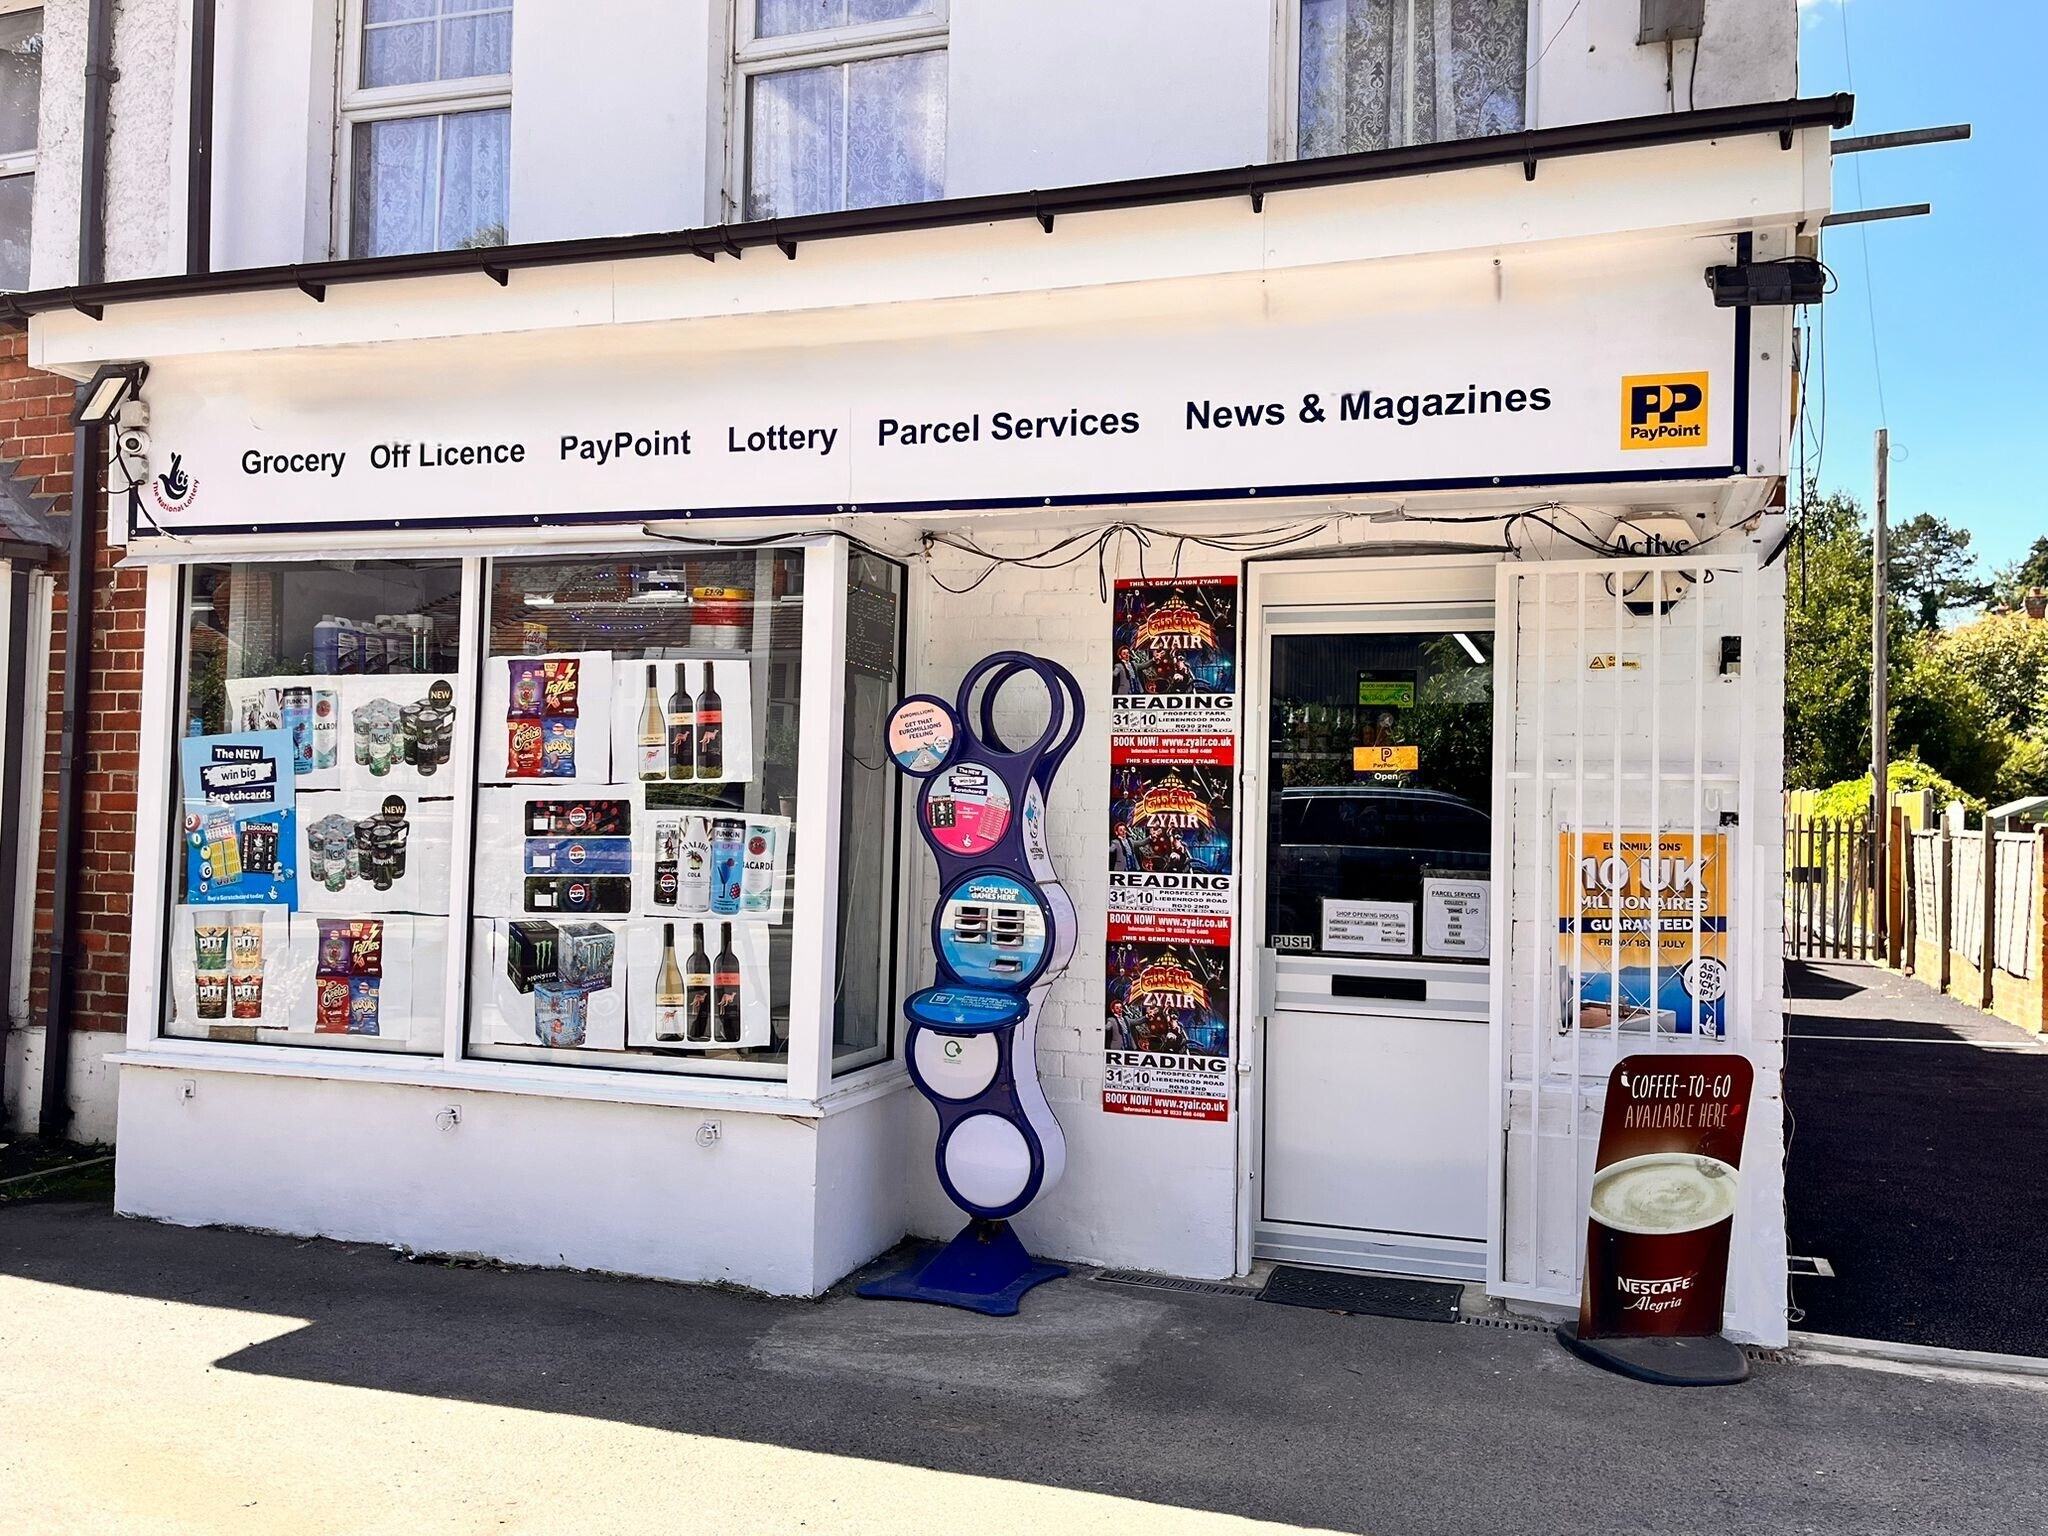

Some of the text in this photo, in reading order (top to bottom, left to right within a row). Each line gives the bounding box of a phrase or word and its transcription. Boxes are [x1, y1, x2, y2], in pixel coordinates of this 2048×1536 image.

[242, 385, 1550, 477] Grocery Off Licence PayPoint Lottery Parcel Services News & Magazines
[1631, 424, 1700, 441] PayPoint
[157, 497, 184, 512] National
[184, 479, 200, 507] Lottery
[1615, 533, 1690, 554] Active
[1150, 635, 1202, 649] ZYAIR
[431, 691, 450, 699] NEW
[1113, 697, 1233, 709] READING
[905, 720, 917, 728] GET
[1114, 714, 1129, 725] 31
[1141, 714, 1156, 725] 10
[899, 722, 942, 735] EUROMILLIONS
[909, 730, 933, 739] FEELING
[1113, 737, 1232, 748] BOOK NOW! www.zyair.co.uk
[215, 749, 260, 759] The NEW
[221, 769, 256, 780] win big
[1374, 773, 1398, 781] Open
[209, 790, 272, 802] Scratchcards
[384, 806, 404, 814] NEW
[1147, 814, 1199, 828] ZYAIR
[1582, 857, 1707, 892] 10 UK
[1110, 874, 1229, 889] READING
[969, 885, 998, 894] CHOOSE
[971, 892, 996, 900] GAMES
[1110, 891, 1125, 902] 31
[1138, 892, 1152, 903] 10
[1110, 914, 1228, 928] BOOK NOW! www.zyair.co.uk
[199, 937, 224, 949] POT
[234, 937, 259, 948] POT
[1273, 936, 1310, 948] PUSH
[1662, 940, 1685, 948] JULY
[1700, 971, 1713, 980] OR
[199, 986, 224, 997] POT
[234, 986, 259, 997] POT
[1700, 989, 1713, 998] IP!
[1143, 993, 1195, 1008] ZYAIR
[1106, 1052, 1226, 1072] READING
[1106, 1070, 1121, 1081] 31
[1134, 1072, 1149, 1083] 10
[1632, 1074, 1731, 1099] COFFEE-TO-GO
[1105, 1093, 1225, 1112] BOOK NOW! www.zyair.co.uk
[1624, 1102, 1728, 1128] AVAILABLE HERE
[1624, 1296, 1682, 1313] Alegria
